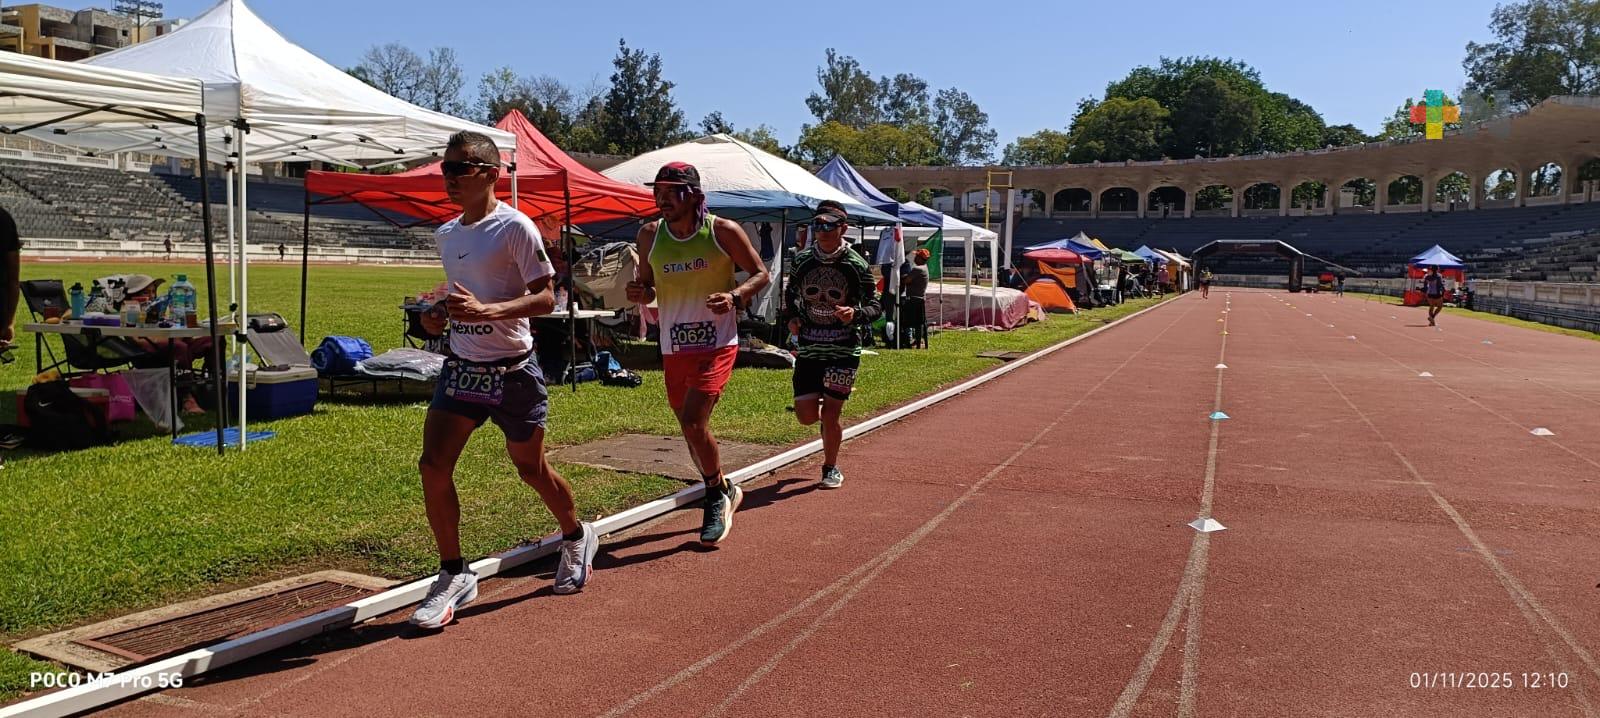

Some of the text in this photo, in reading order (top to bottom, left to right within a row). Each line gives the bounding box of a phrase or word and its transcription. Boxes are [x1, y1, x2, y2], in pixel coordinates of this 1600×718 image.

[678, 328, 707, 344] 062
[458, 372, 492, 392] 073
[830, 372, 852, 386] 086
